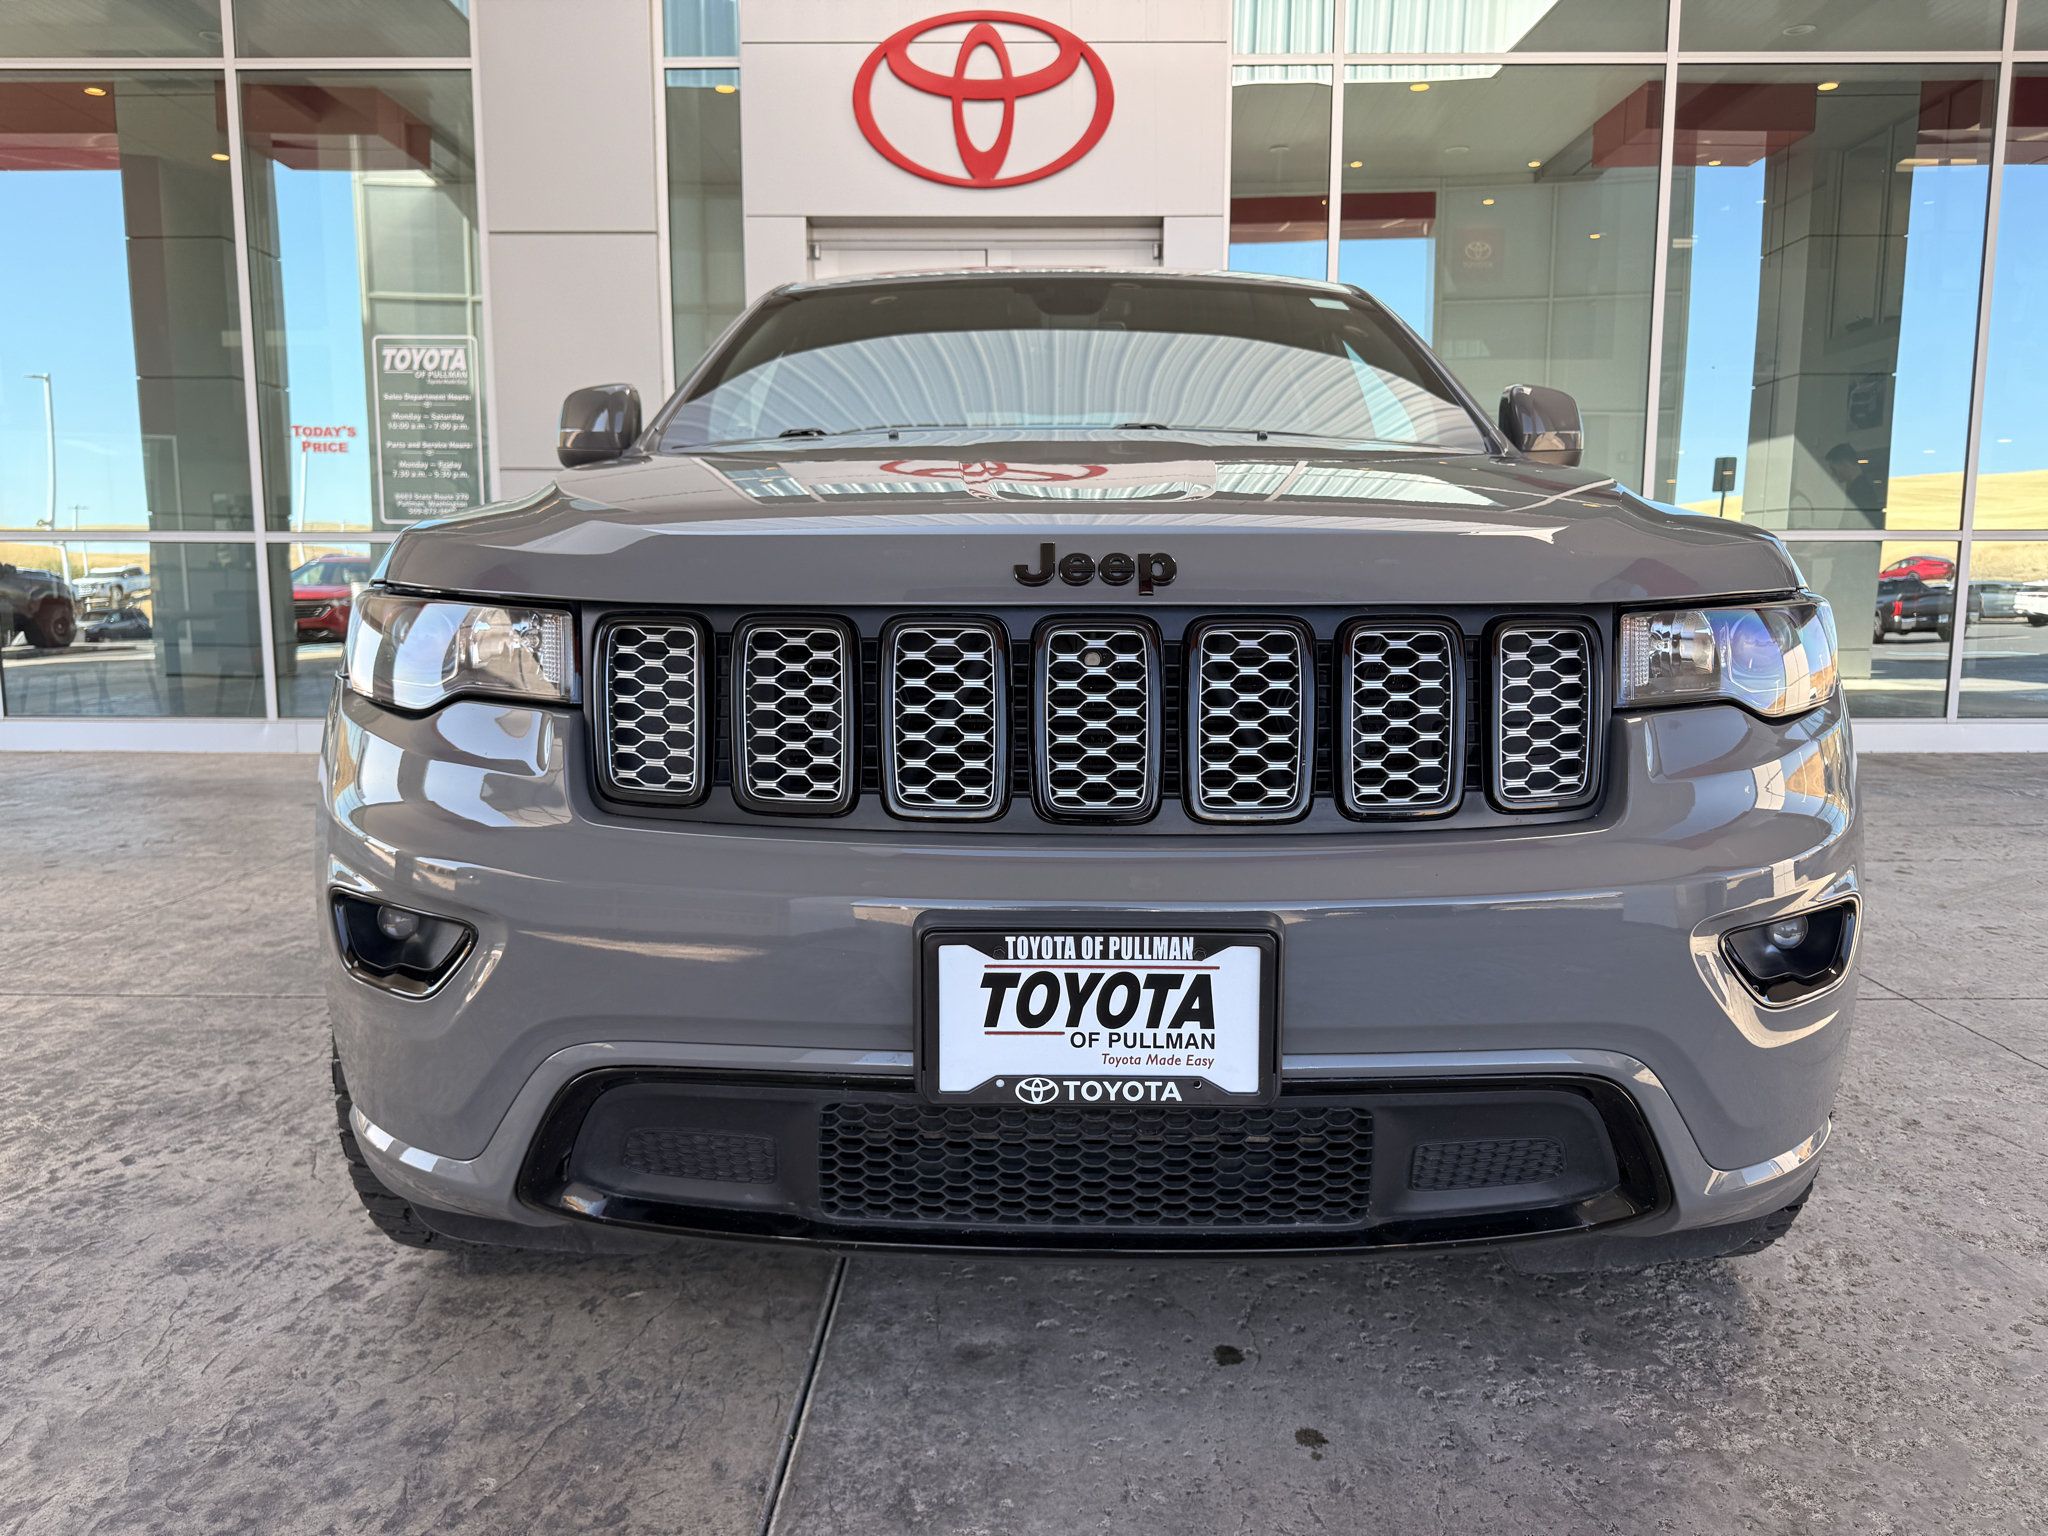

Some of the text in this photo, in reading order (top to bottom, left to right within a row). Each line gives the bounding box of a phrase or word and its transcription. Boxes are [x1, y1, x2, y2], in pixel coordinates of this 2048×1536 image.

[381, 348, 467, 371] TOYOTA
[391, 412, 421, 422] Monday
[430, 412, 465, 422] Saturday
[292, 425, 357, 437] TODAY'S
[301, 441, 349, 454] PRICE
[1013, 541, 1178, 597] Jeep
[1005, 936, 1194, 960] TOYOTA OF PULLMAN
[980, 971, 1216, 1030] TOYOTA
[1070, 1031, 1215, 1050] OF PULLMAN
[1101, 1052, 1215, 1070] Toyota Made Easy
[1062, 1080, 1183, 1102] TOYOTA
